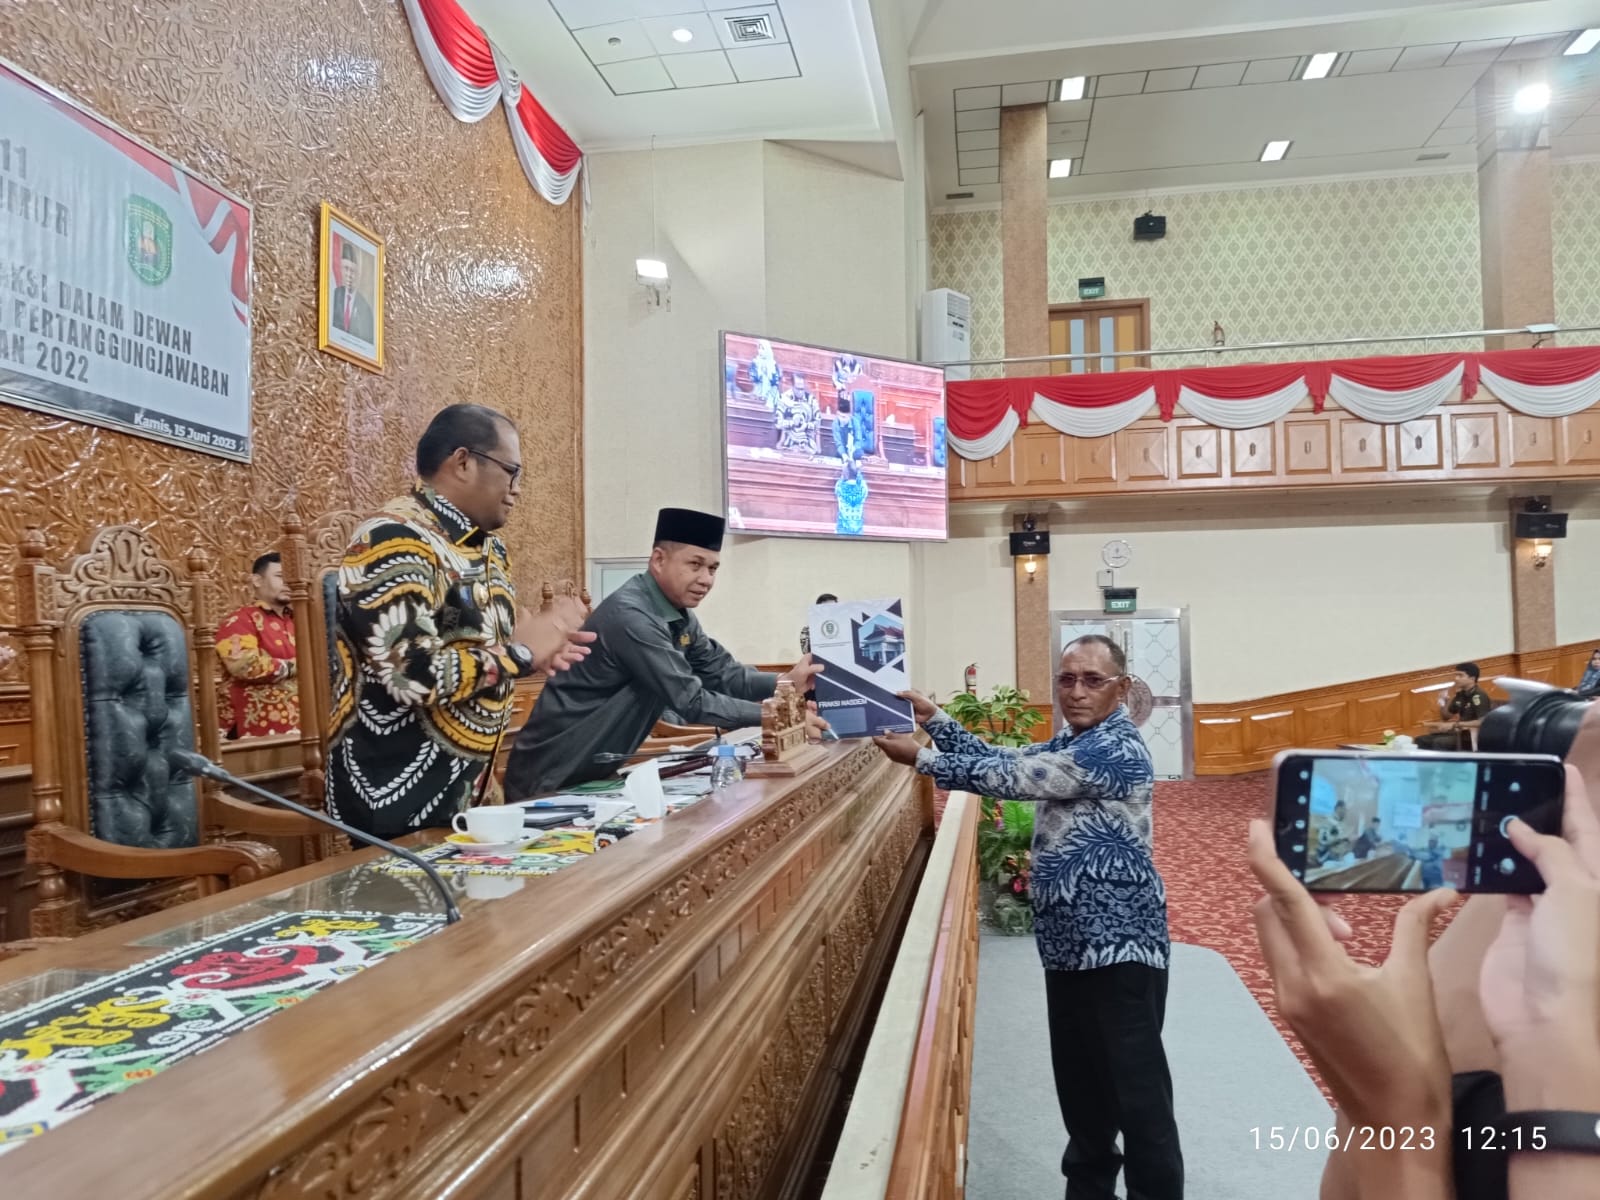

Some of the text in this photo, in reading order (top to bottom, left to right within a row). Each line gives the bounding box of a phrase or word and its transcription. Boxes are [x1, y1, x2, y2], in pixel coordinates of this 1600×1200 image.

[59, 280, 124, 331] DALAM
[134, 309, 192, 355] DEWAN
[14, 298, 229, 397] PERTANGGUNGJAWABAN
[36, 341, 89, 384] 2022
[134, 412, 237, 449] Kamis, 15 Juni 2023
[1111, 601, 1130, 609] EXIT
